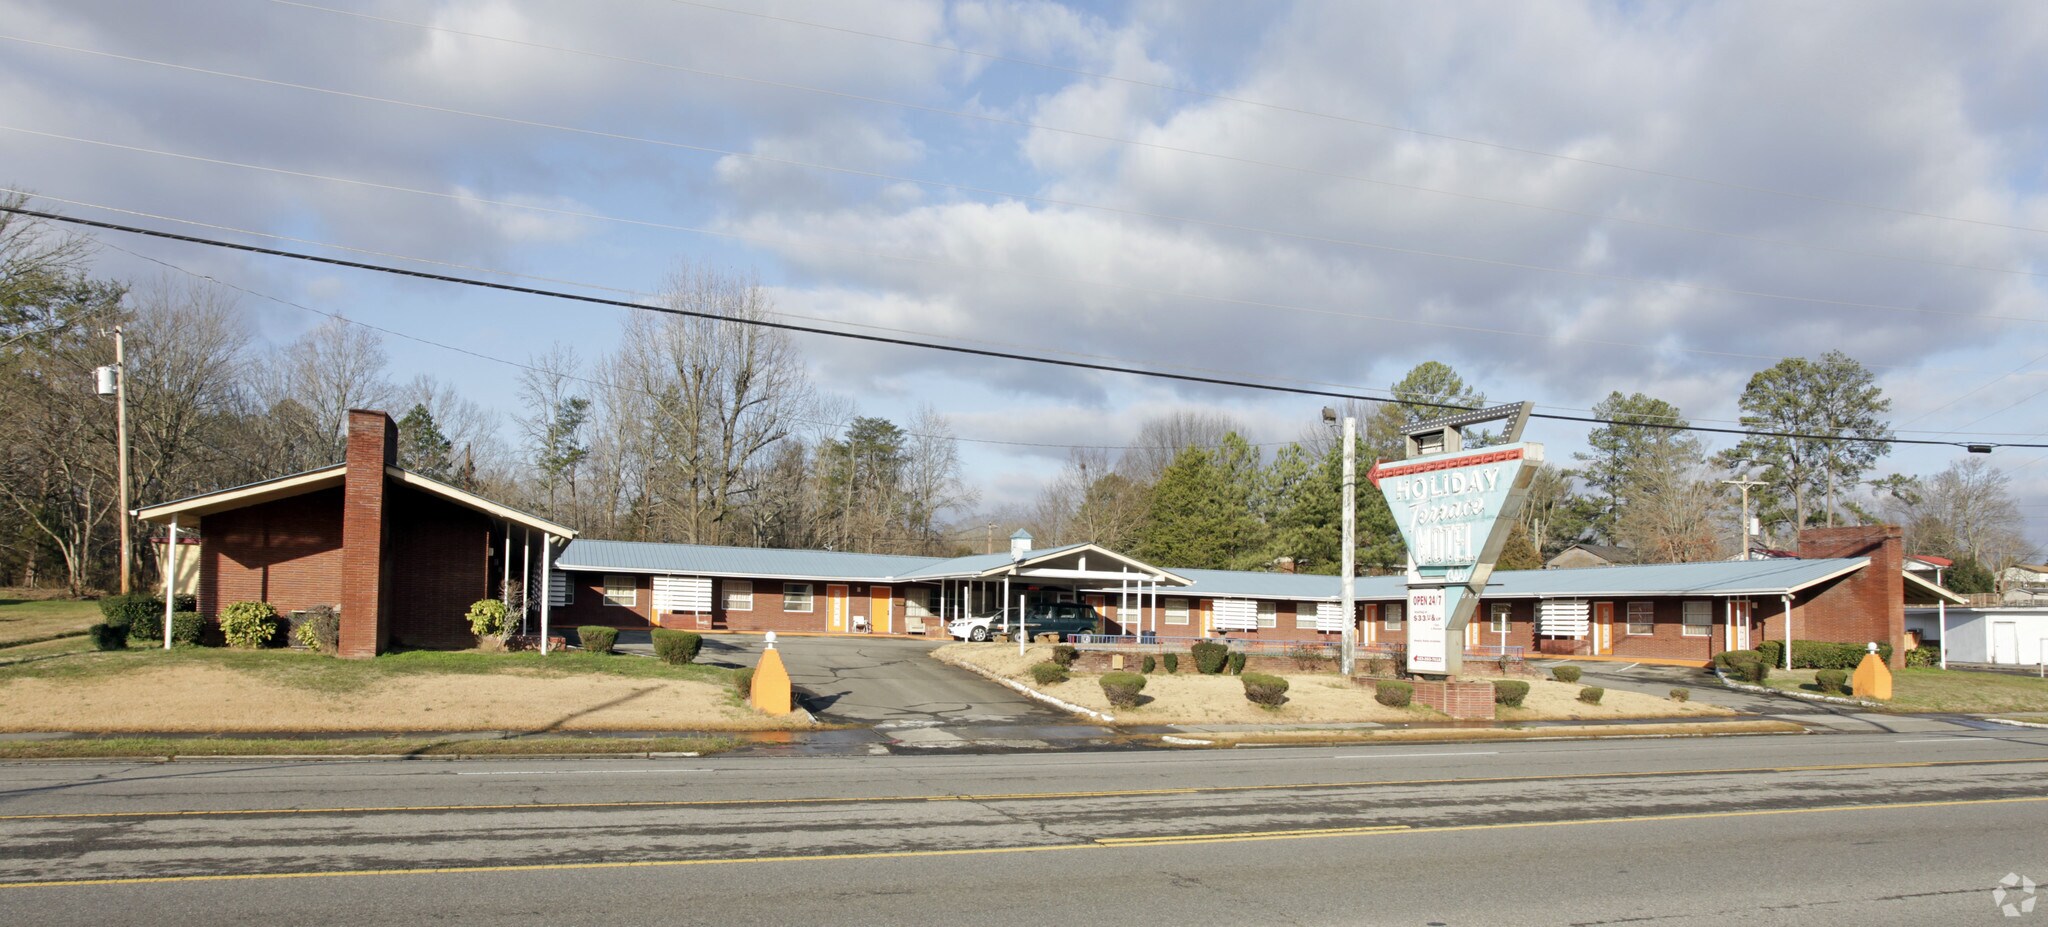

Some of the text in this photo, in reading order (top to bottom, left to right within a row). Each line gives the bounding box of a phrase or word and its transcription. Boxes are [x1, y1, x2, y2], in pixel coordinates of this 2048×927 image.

[1396, 468, 1499, 500] HOLIDAY
[1408, 497, 1485, 533] Terrace
[1415, 523, 1476, 564] MOTEL
[1413, 596, 1427, 605] OPEN
